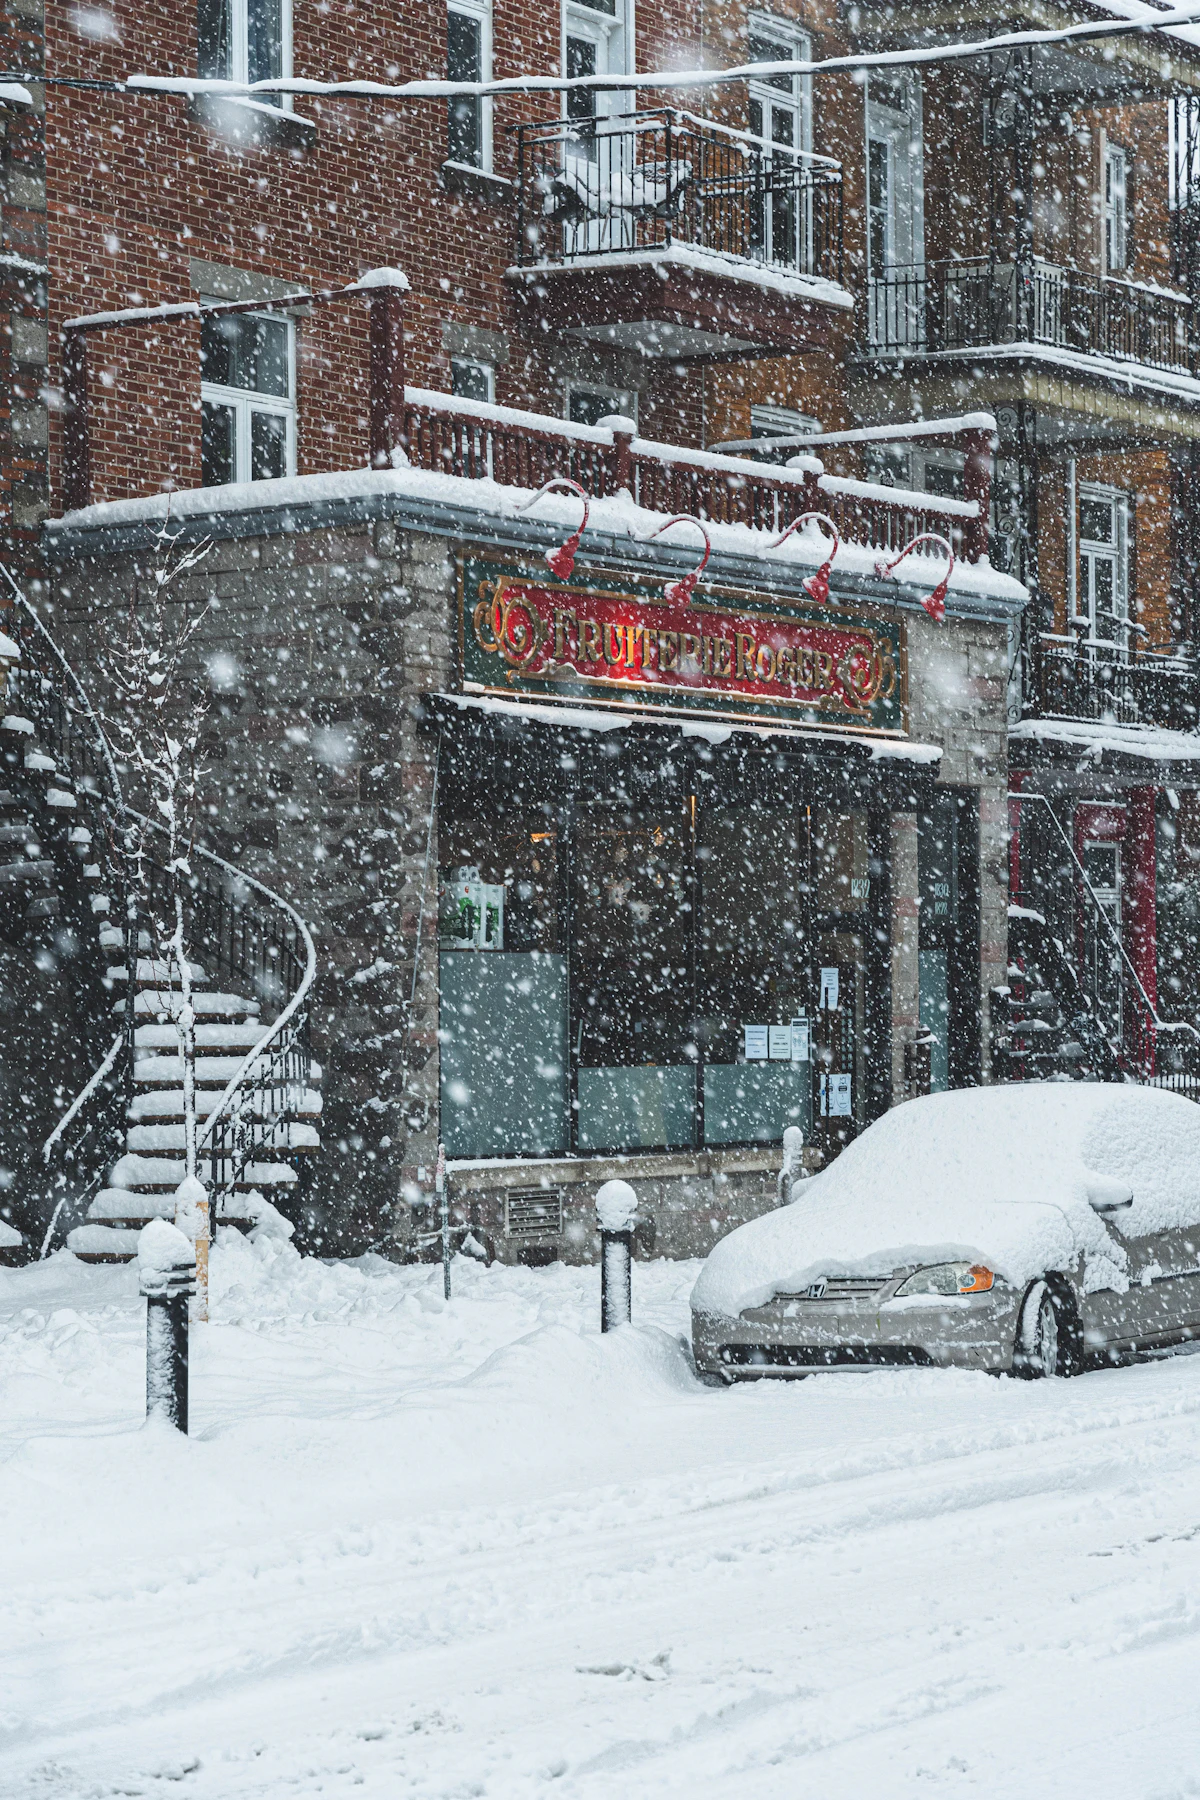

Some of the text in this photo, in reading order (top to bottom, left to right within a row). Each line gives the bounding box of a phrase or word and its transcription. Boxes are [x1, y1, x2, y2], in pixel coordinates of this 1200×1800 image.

[552, 608, 835, 690] FRUITERIE ROGER
[851, 878, 870, 898] 1832
